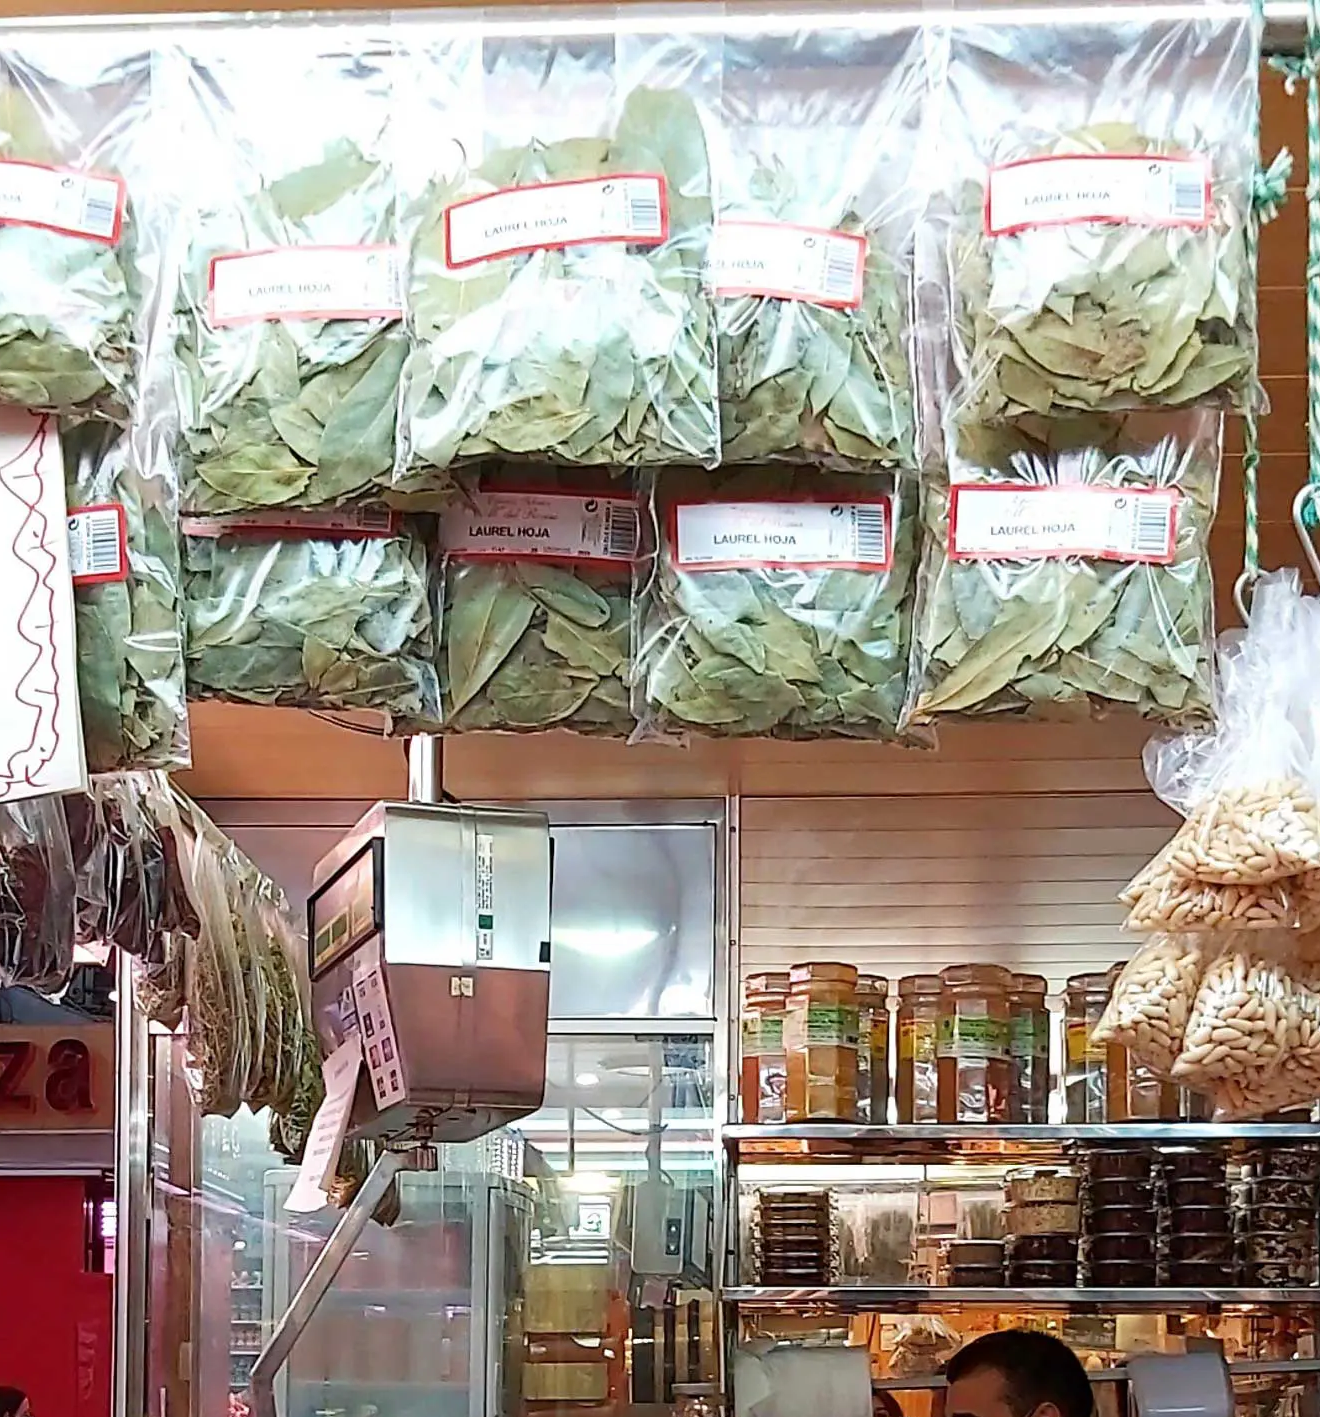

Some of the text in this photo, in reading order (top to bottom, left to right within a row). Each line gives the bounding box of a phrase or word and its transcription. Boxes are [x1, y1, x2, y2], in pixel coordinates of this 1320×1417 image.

[468, 525, 550, 539] LAUREL HOJA
[990, 522, 1076, 537] LAUREL HOJA
[713, 533, 797, 547] LAUREL HOJA
